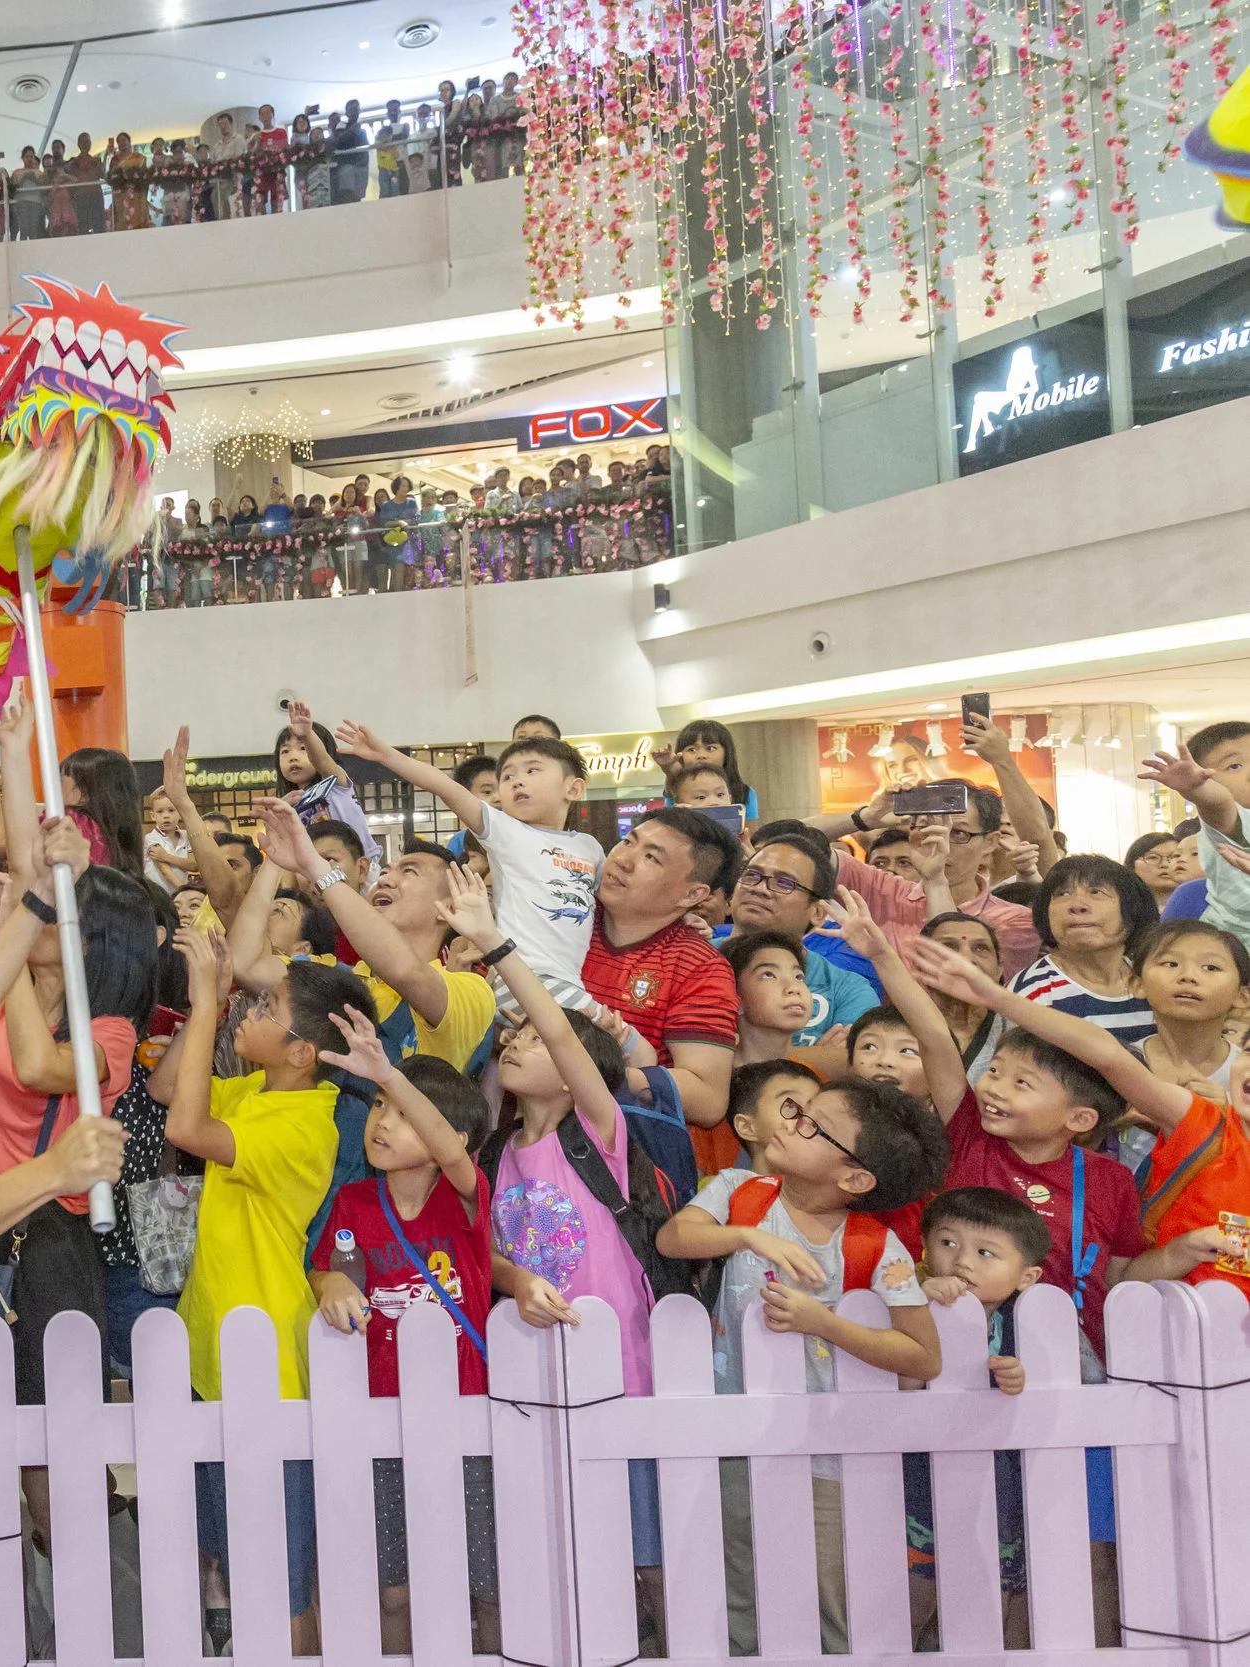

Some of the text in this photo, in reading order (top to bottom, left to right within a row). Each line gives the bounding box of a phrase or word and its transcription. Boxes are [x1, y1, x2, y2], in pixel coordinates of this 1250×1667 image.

[1158, 320, 1250, 373] Fashi
[1007, 373, 1100, 421] Mobile
[529, 398, 663, 448] FOX
[185, 769, 277, 788] nderground
